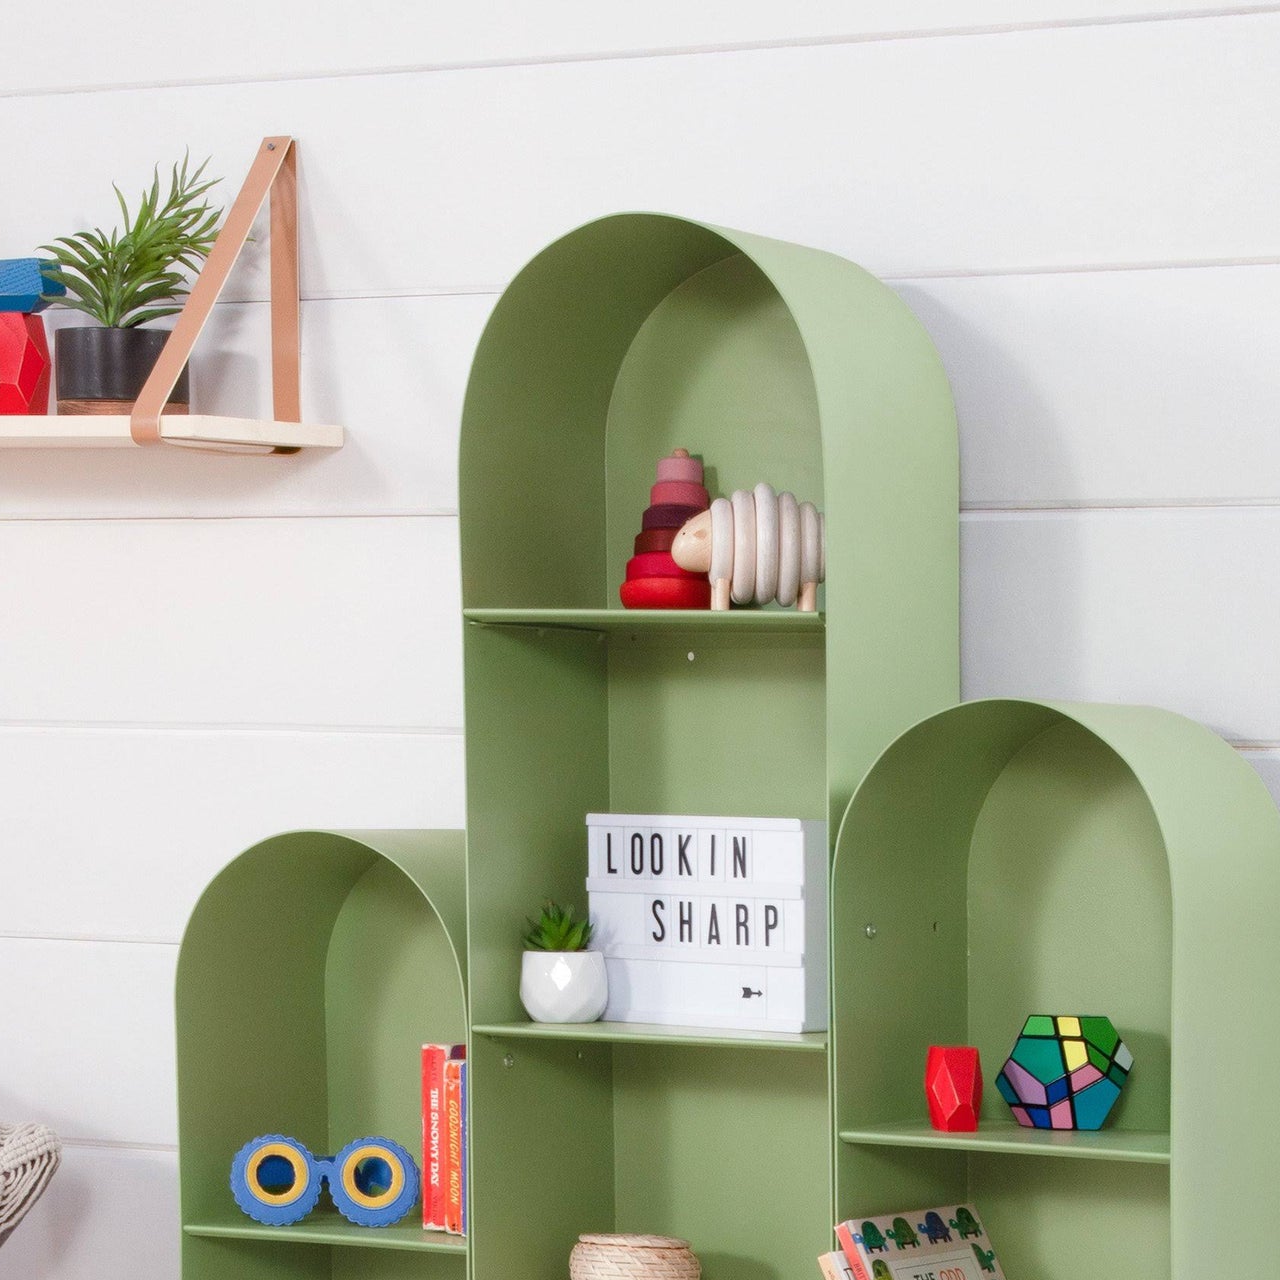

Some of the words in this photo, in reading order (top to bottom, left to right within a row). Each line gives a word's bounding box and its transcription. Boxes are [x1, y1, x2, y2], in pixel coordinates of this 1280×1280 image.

[606, 832, 747, 878] LOOKIN
[651, 899, 779, 947] SHARP
[430, 1088, 438, 1109] THE
[430, 1112, 439, 1160] SNOWY
[449, 1099, 459, 1167] GOODNIGHT
[431, 1162, 439, 1186] DAY
[450, 1170, 458, 1205] MOON
